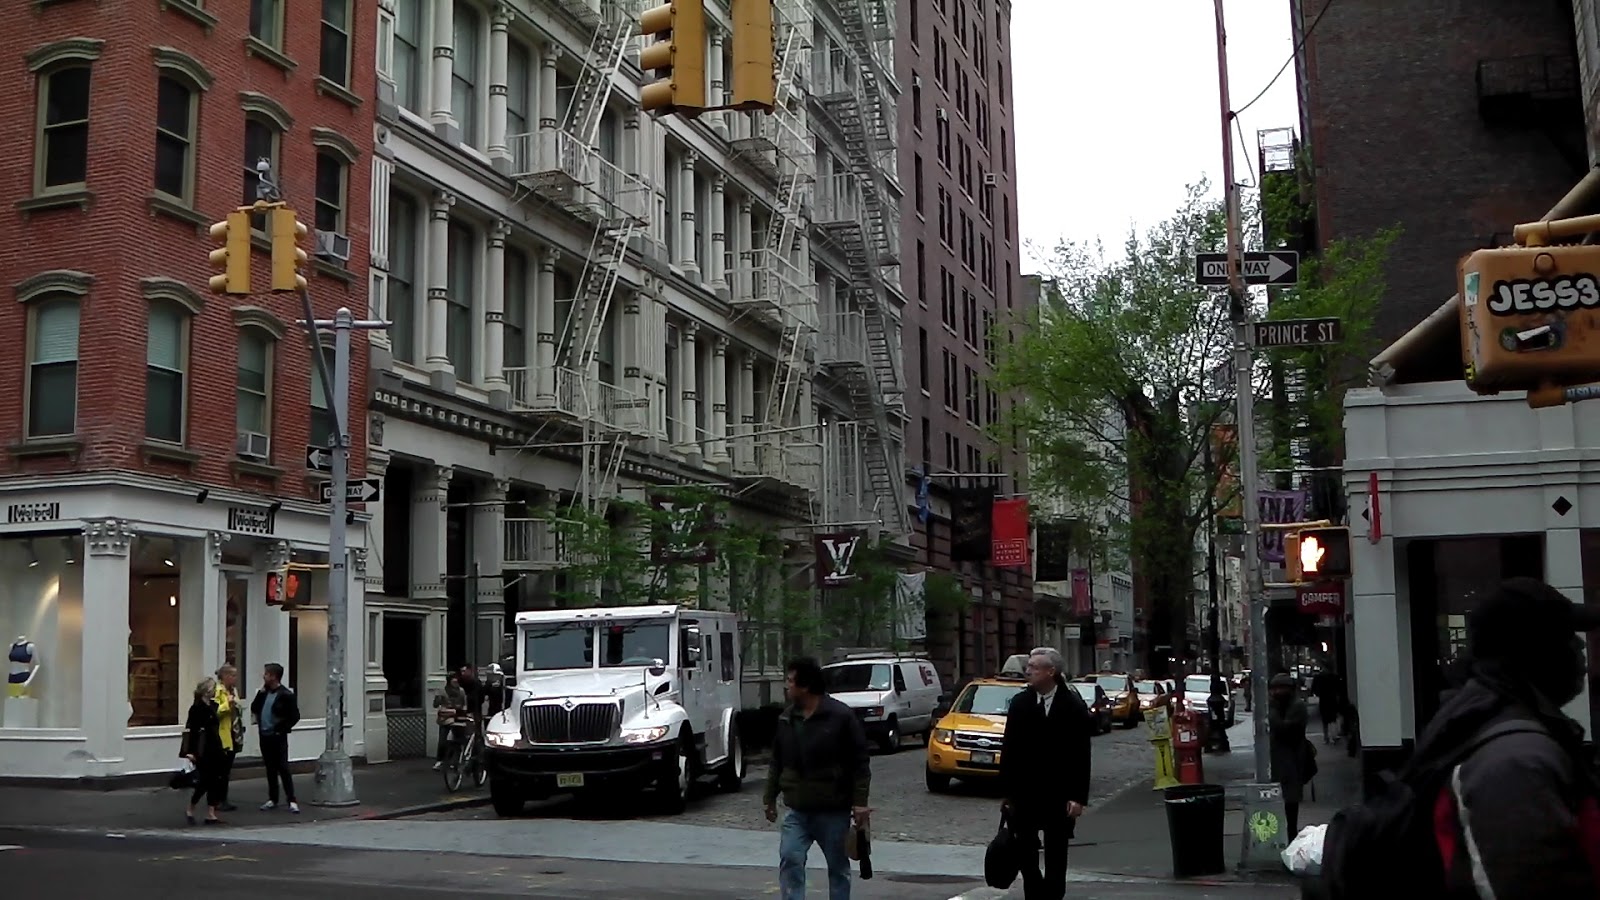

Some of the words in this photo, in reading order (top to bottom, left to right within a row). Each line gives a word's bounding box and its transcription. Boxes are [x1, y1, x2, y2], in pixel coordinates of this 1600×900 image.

[1206, 263, 1229, 276] ON
[1490, 277, 1600, 313] JESS3
[1259, 324, 1309, 345] PRINCE
[1318, 322, 1335, 342] ST
[1301, 592, 1341, 606] CAMPER
